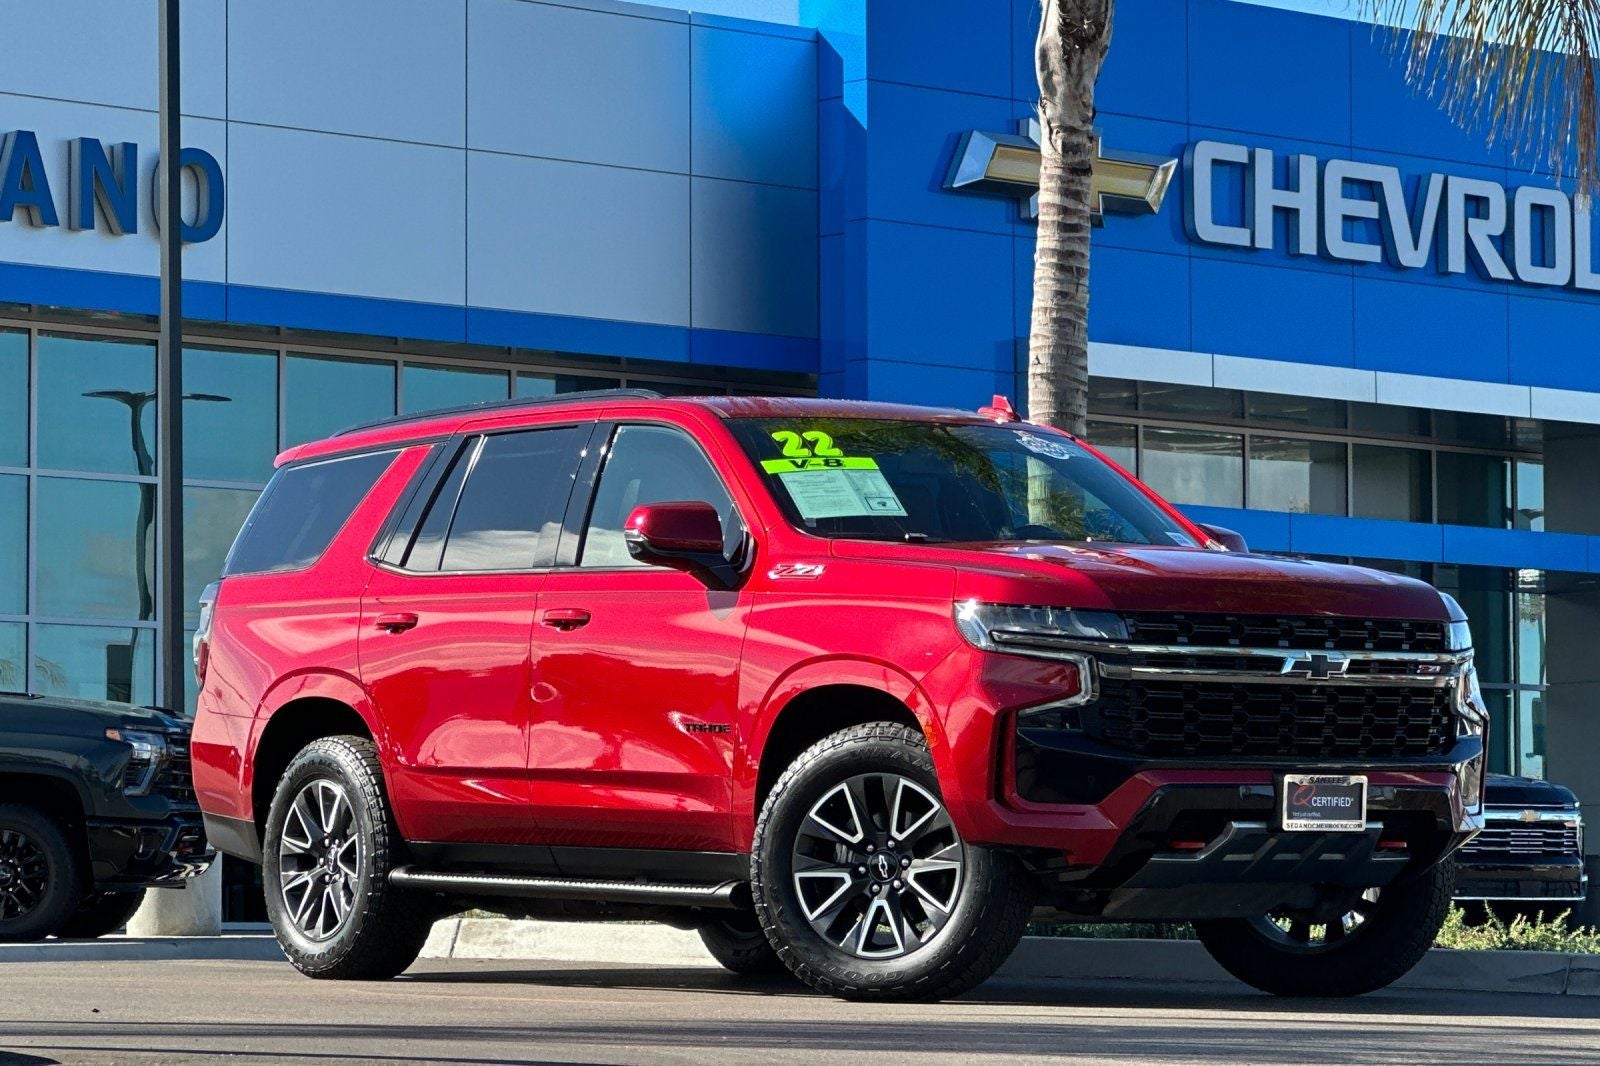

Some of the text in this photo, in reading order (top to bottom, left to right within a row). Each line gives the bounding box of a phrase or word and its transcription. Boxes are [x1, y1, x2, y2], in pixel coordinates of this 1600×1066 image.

[771, 430, 844, 458] 22
[789, 458, 844, 469] V-8
[684, 723, 731, 733] TAHOE
